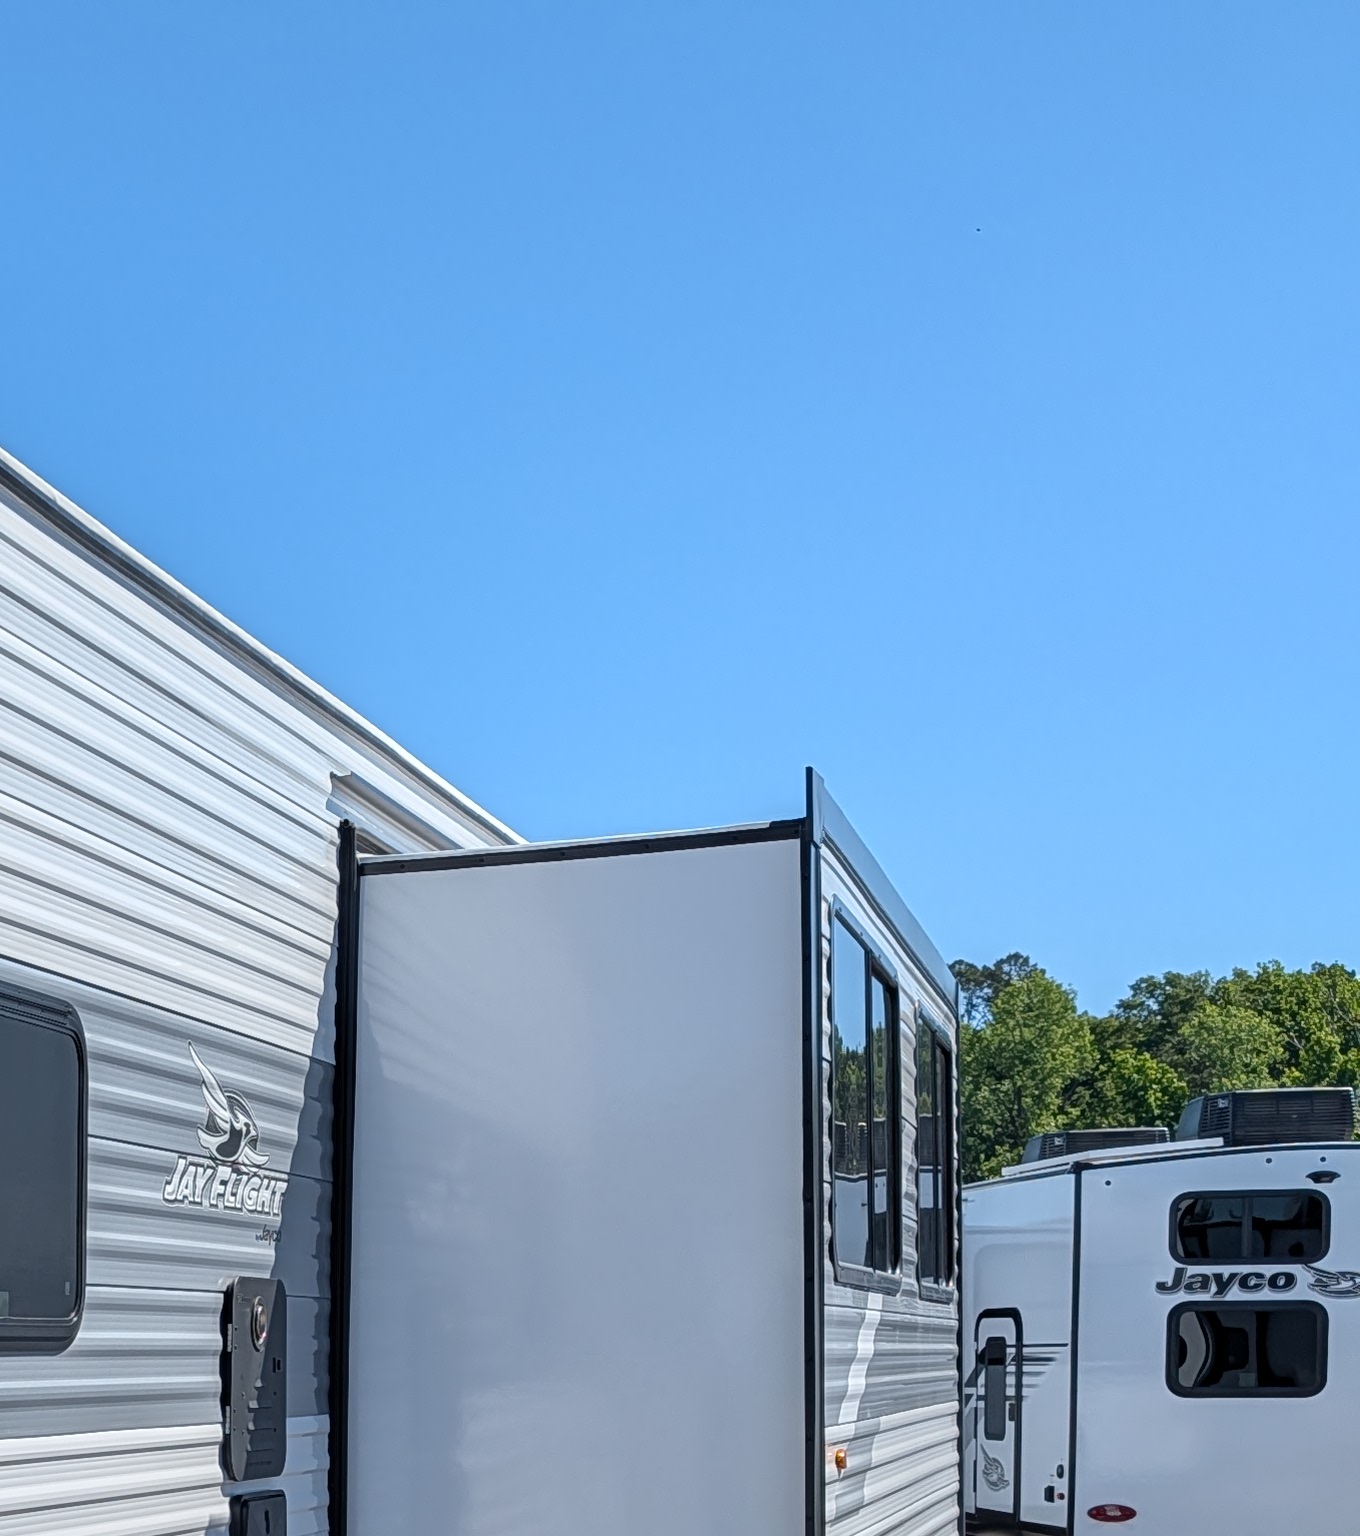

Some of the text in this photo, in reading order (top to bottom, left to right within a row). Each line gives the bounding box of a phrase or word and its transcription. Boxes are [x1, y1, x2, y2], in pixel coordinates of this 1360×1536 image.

[162, 1156, 288, 1219] JAY FLIGHT
[1155, 1267, 1298, 1298] Jayco
